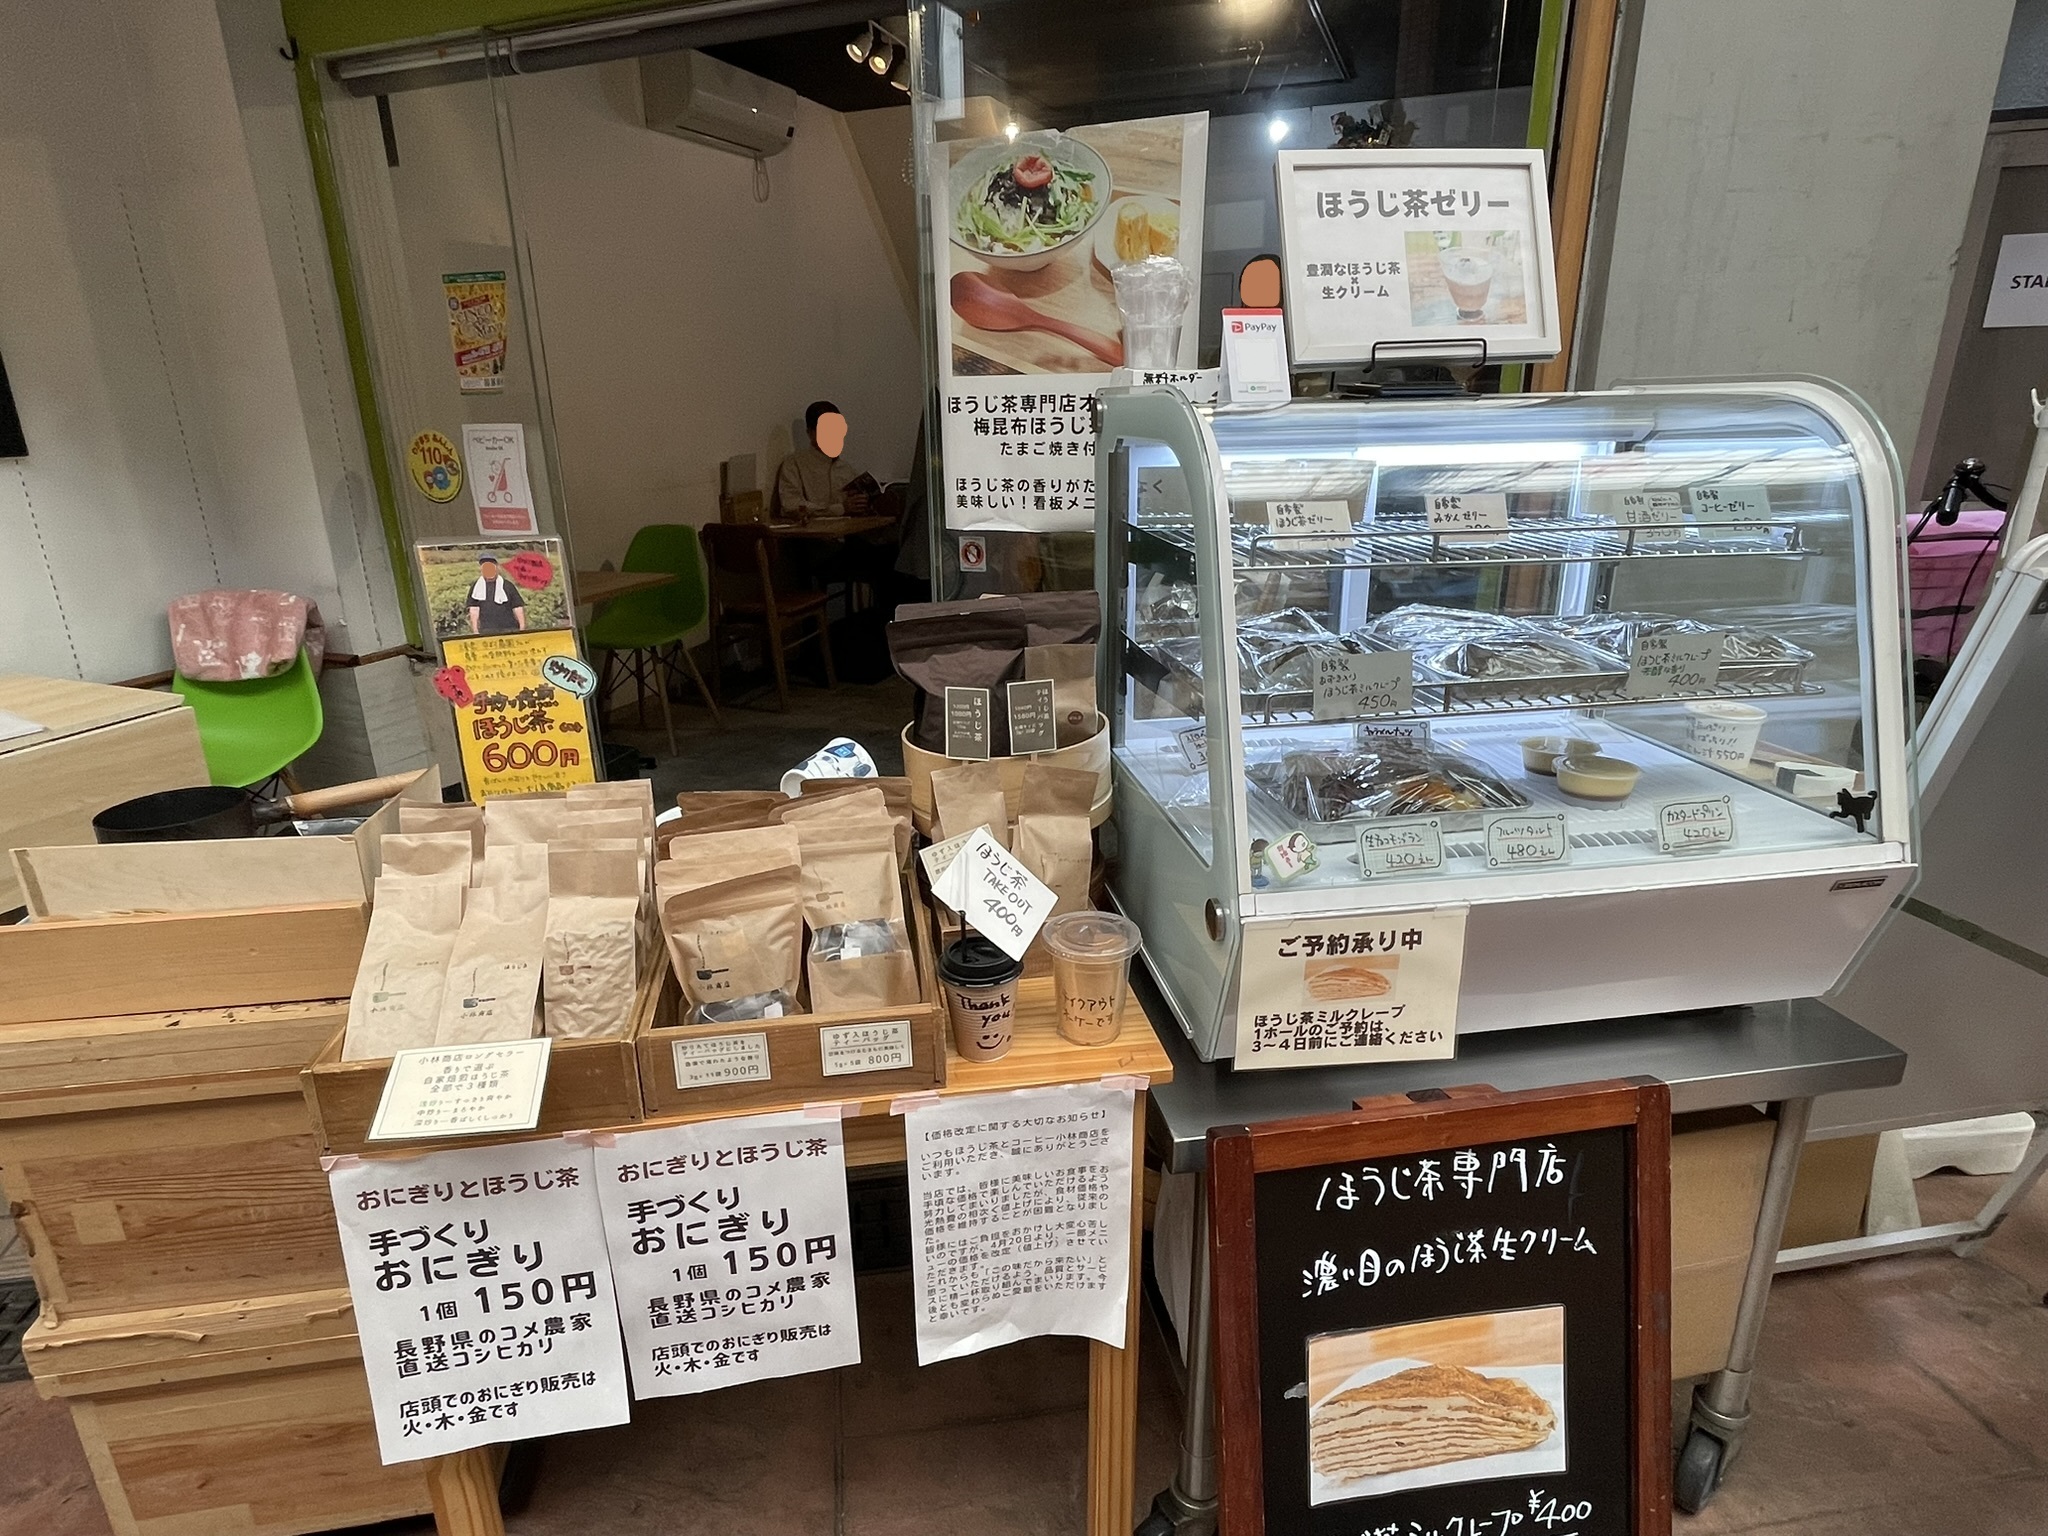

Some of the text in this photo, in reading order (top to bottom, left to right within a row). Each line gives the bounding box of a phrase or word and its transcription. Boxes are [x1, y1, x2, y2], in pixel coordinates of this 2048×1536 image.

[1316, 188, 1510, 219] ほうじ茶ゼリー
[1306, 261, 1400, 278] 豊潤なほうじ茶
[1322, 285, 1390, 300] 生クリーム
[1245, 322, 1277, 333] PayPay
[1000, 441, 1096, 457] たまご焼き付
[955, 477, 1096, 494] ほうじ茶の香りがた
[955, 494, 1096, 511] 美味しい！看板メニ
[1433, 510, 1488, 524] みかんゼリー
[1701, 501, 1755, 513] コーヒーゼリー
[1275, 514, 1334, 529] ほうじ茶ゼリー
[1636, 648, 1713, 668] ほうじ茶ミルクレープ
[1323, 676, 1402, 699] ほうじ茶ミルクレープ
[1668, 672, 1707, 688] 400円
[1358, 693, 1398, 710] 450円
[472, 710, 555, 741] ほうじ茶
[973, 697, 982, 742] ほうじ茶
[482, 740, 580, 773] 600円
[1716, 750, 1745, 760] 550円
[975, 842, 1028, 889] ほうじ茶
[983, 867, 1034, 916] TAKE OUT
[983, 897, 1024, 937] 400円
[1278, 928, 1423, 957] ご予約承り中
[957, 993, 1012, 1011] Thank
[1254, 1003, 1406, 1028] ほうじ茶ミルクレープ
[981, 1009, 1011, 1028] you
[724, 1064, 760, 1077] 900円
[868, 1052, 902, 1065] 800円
[617, 1137, 828, 1184] おにぎりとほうじ茶
[922, 1168, 960, 1180] います。
[356, 1166, 580, 1211] おにぎりとほうじ茶
[1315, 1144, 1567, 1211] ほうじ茶専門店
[627, 1186, 741, 1225] 手づくり
[368, 1219, 490, 1257] 手づくり
[631, 1207, 790, 1256] おにぎり
[374, 1241, 545, 1292] おにぎり
[672, 1234, 838, 1282] 1個 150円
[1302, 1226, 1598, 1298] 濃い目のほうじ茶生クリーム
[419, 1271, 598, 1322] 1個 150円
[647, 1271, 831, 1314] 長野県のコメ農家
[649, 1294, 795, 1329] 直送コシヒカリ
[394, 1312, 593, 1361] 長野県のコメ農家
[652, 1323, 832, 1362] 店頭でのおにぎり販売は
[396, 1337, 554, 1379] 直送コシヒカリ
[654, 1348, 760, 1378] 火・木・金です
[399, 1370, 597, 1419] 店頭でのおにぎり販売は
[402, 1401, 519, 1438] 火・木・金です
[1528, 1488, 1592, 1529] ¥400
